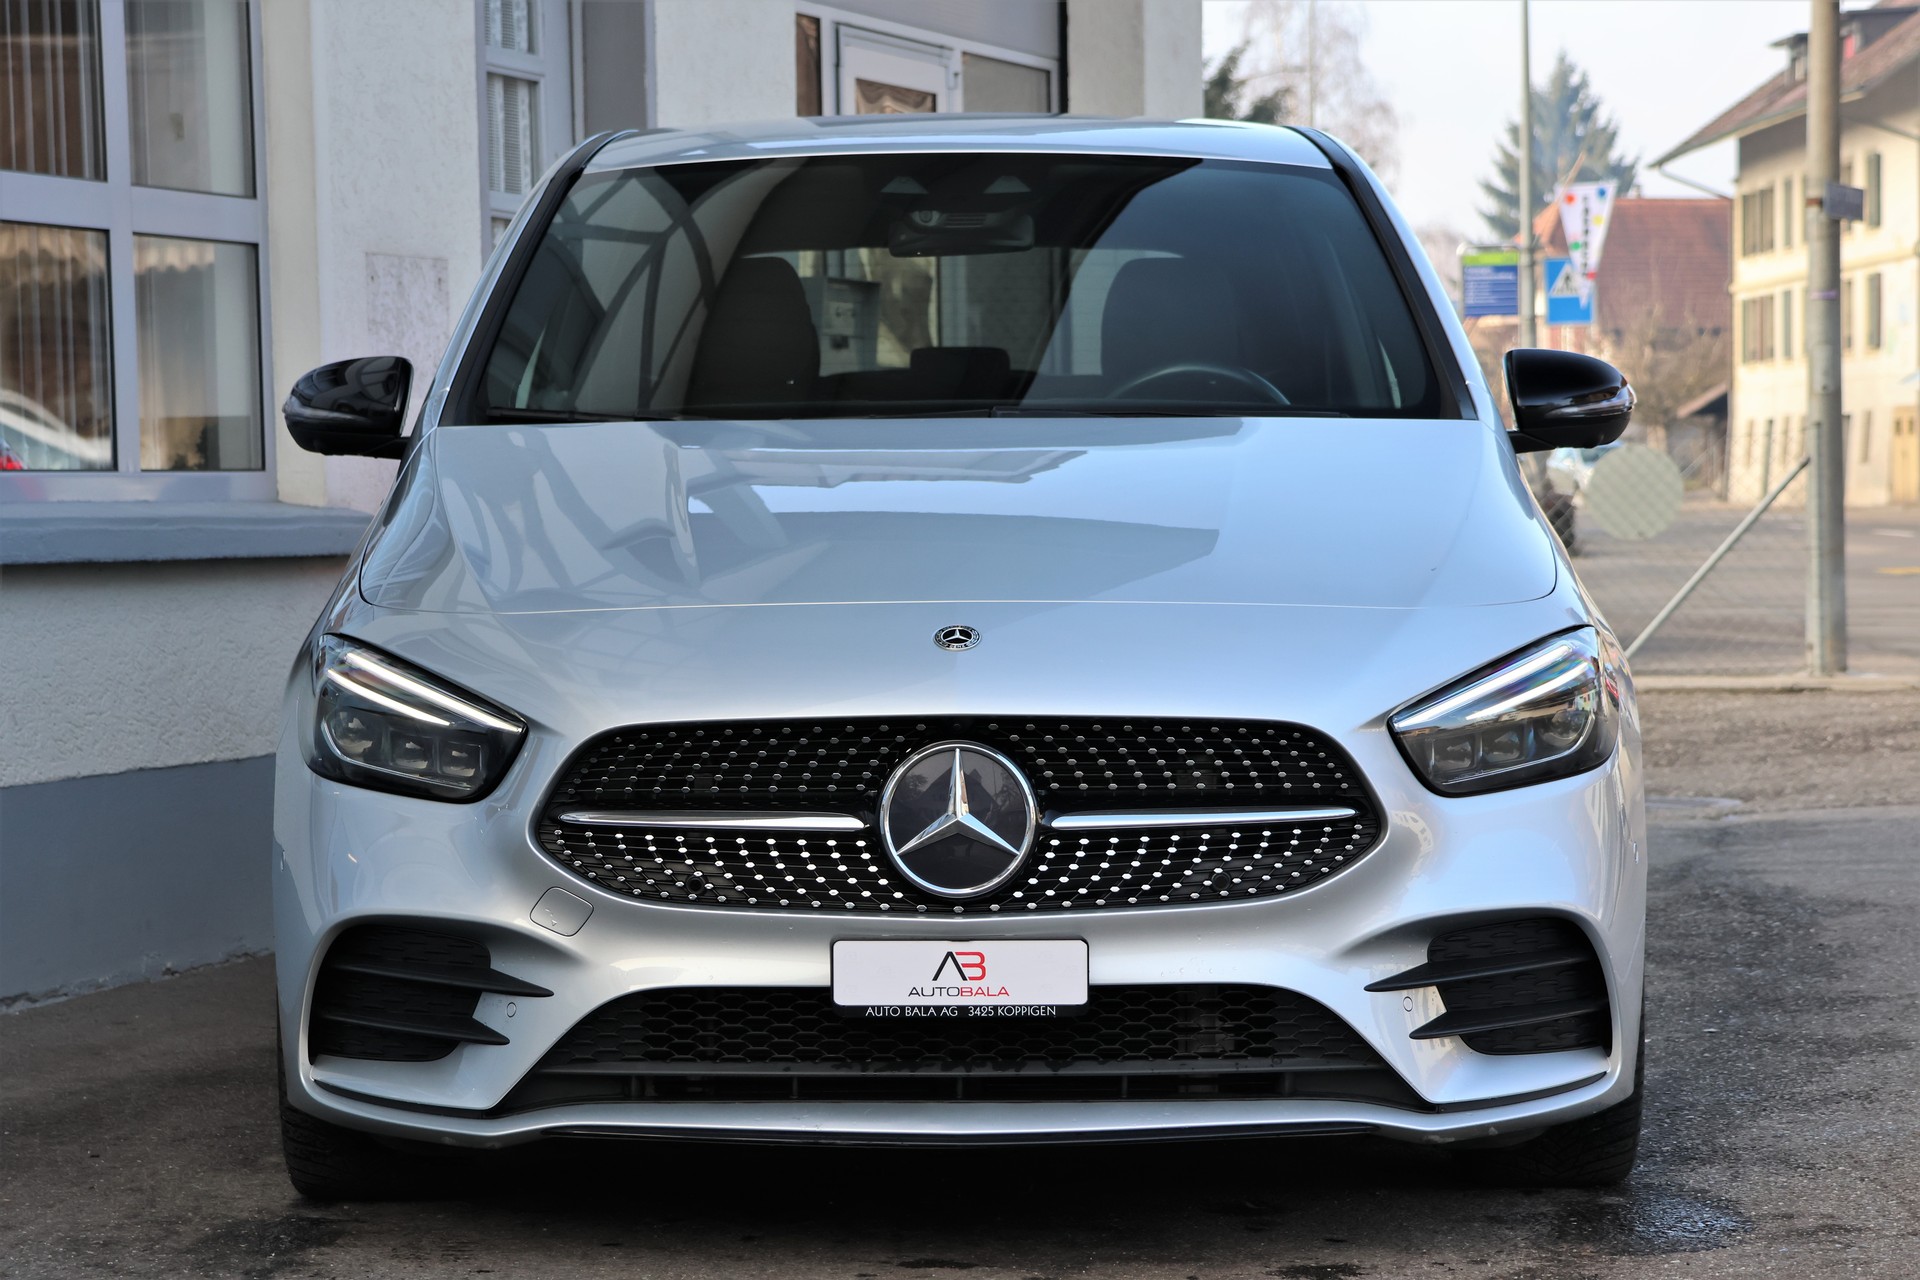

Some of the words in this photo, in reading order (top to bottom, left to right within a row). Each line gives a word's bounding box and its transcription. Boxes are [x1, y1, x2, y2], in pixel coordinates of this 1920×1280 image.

[932, 951, 986, 981] AB
[908, 986, 1010, 997] AUTOBALA
[865, 1006, 900, 1017] AUTO
[905, 1006, 936, 1017] BALA
[940, 1006, 958, 1017] AG
[968, 1006, 994, 1016] 3425
[998, 1005, 1056, 1016] KOPPIGEN
